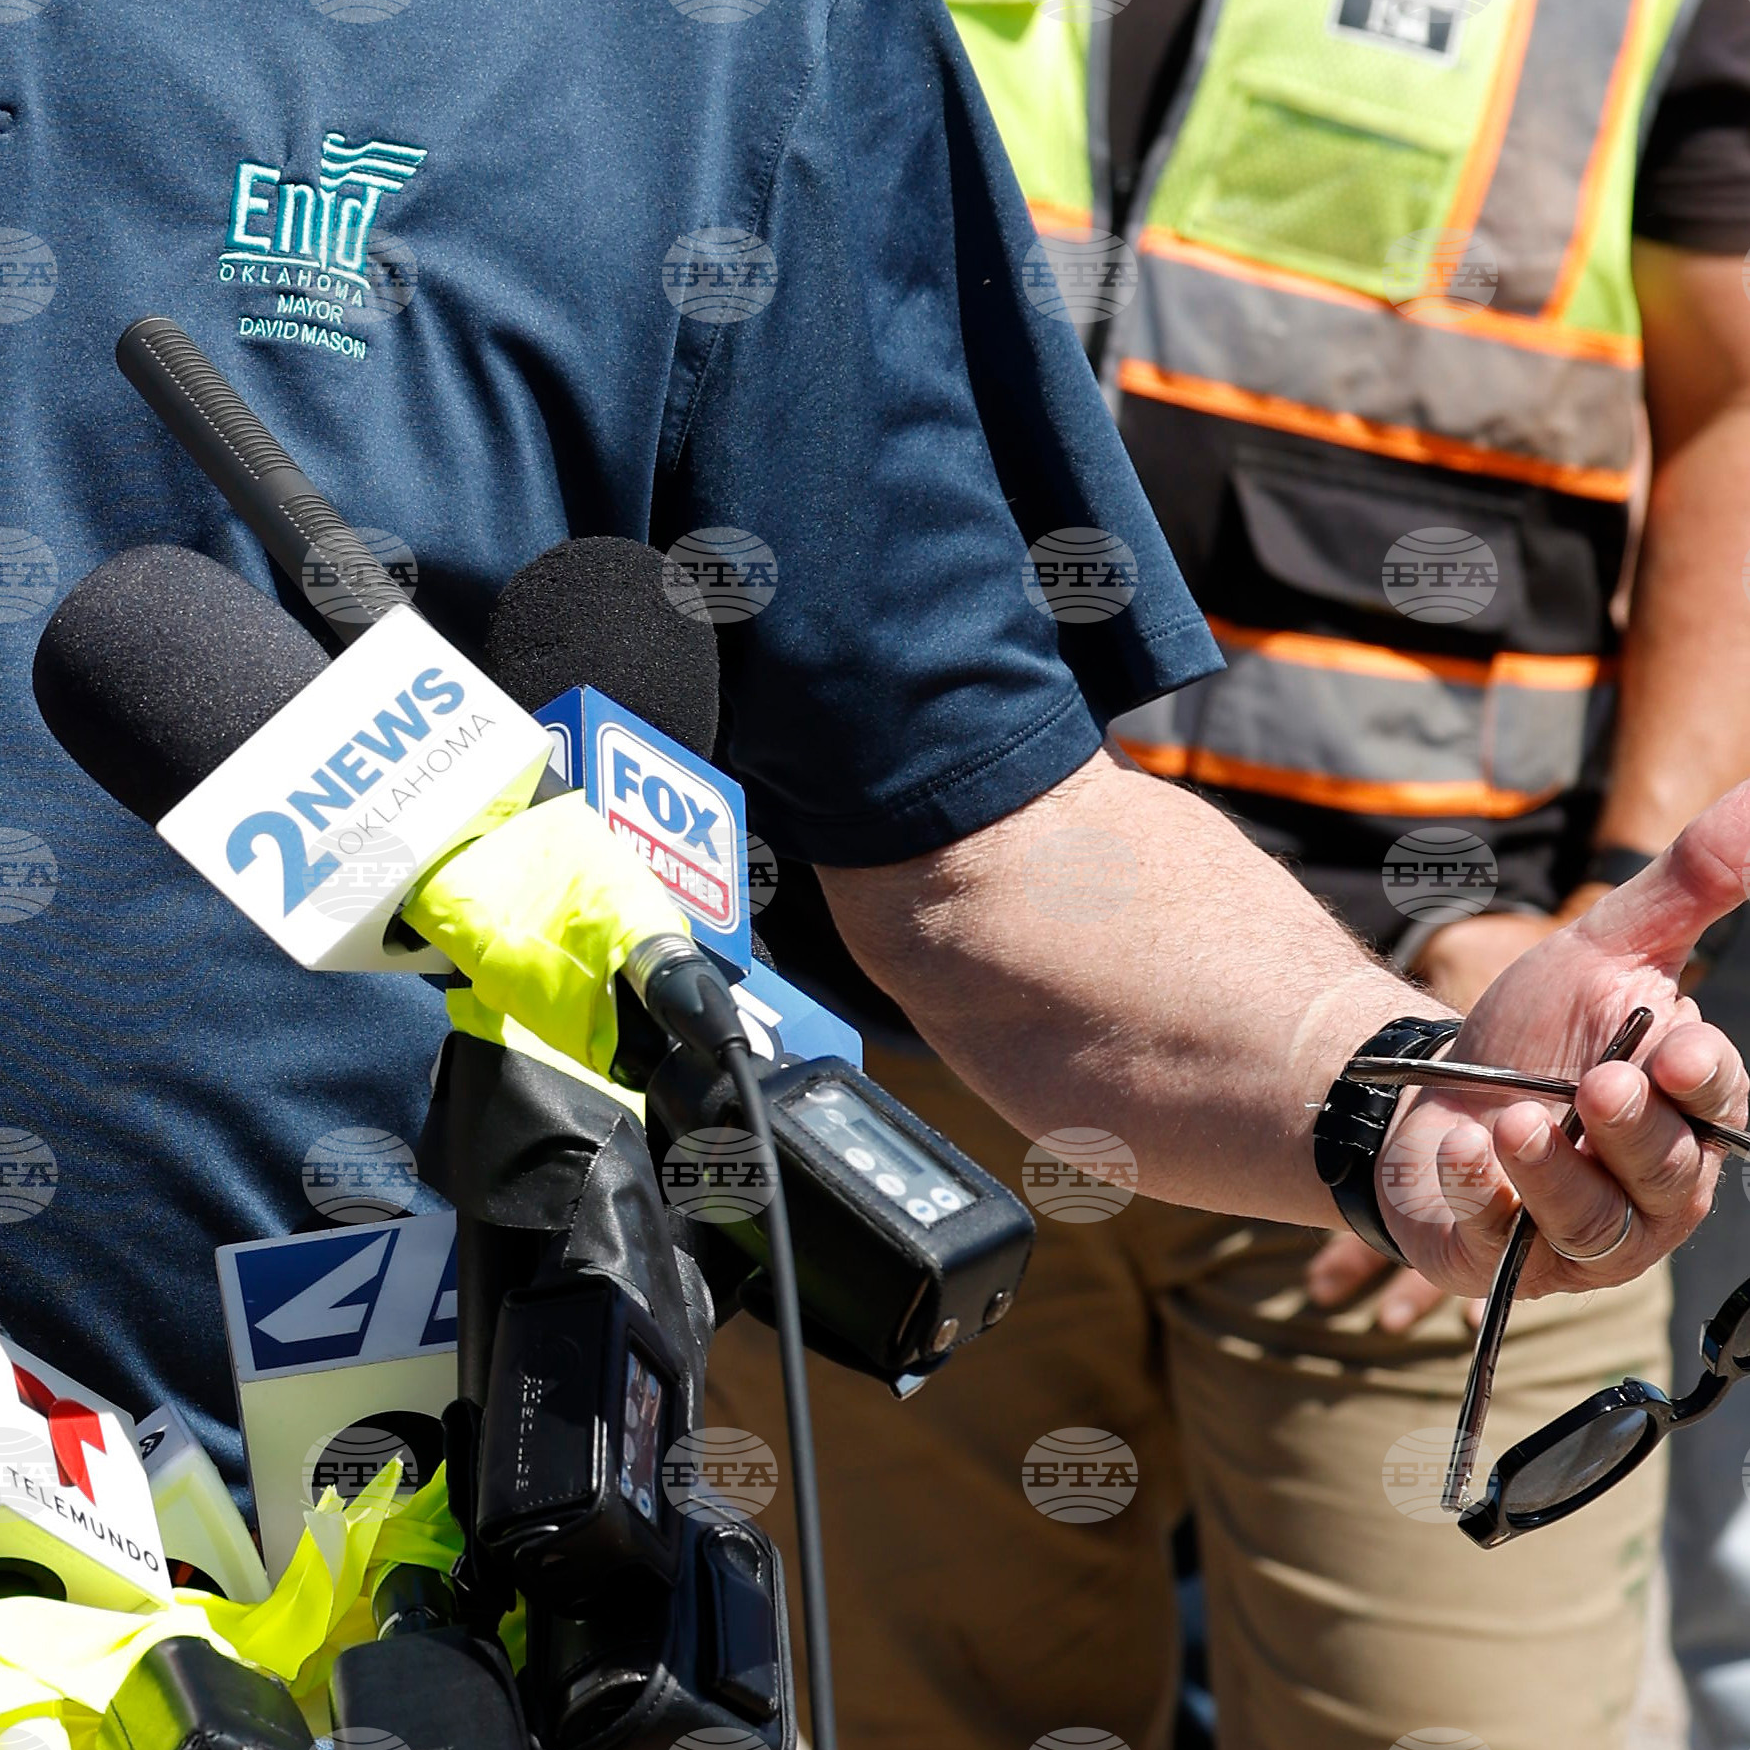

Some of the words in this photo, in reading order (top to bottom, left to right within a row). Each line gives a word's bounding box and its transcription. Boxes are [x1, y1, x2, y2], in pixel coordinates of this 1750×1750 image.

[218, 262, 364, 307] OKLAHOMA
[276, 293, 345, 324] MAYOR
[238, 316, 298, 339] DAVID
[301, 322, 368, 360] MASON
[224, 788, 342, 919] 2
[287, 667, 467, 833] NEWS
[337, 710, 497, 855] OKLAHOMA
[611, 748, 722, 863] FOX
[612, 817, 725, 917] WEATHER
[6, 1465, 160, 1574] TELEMUNDO
